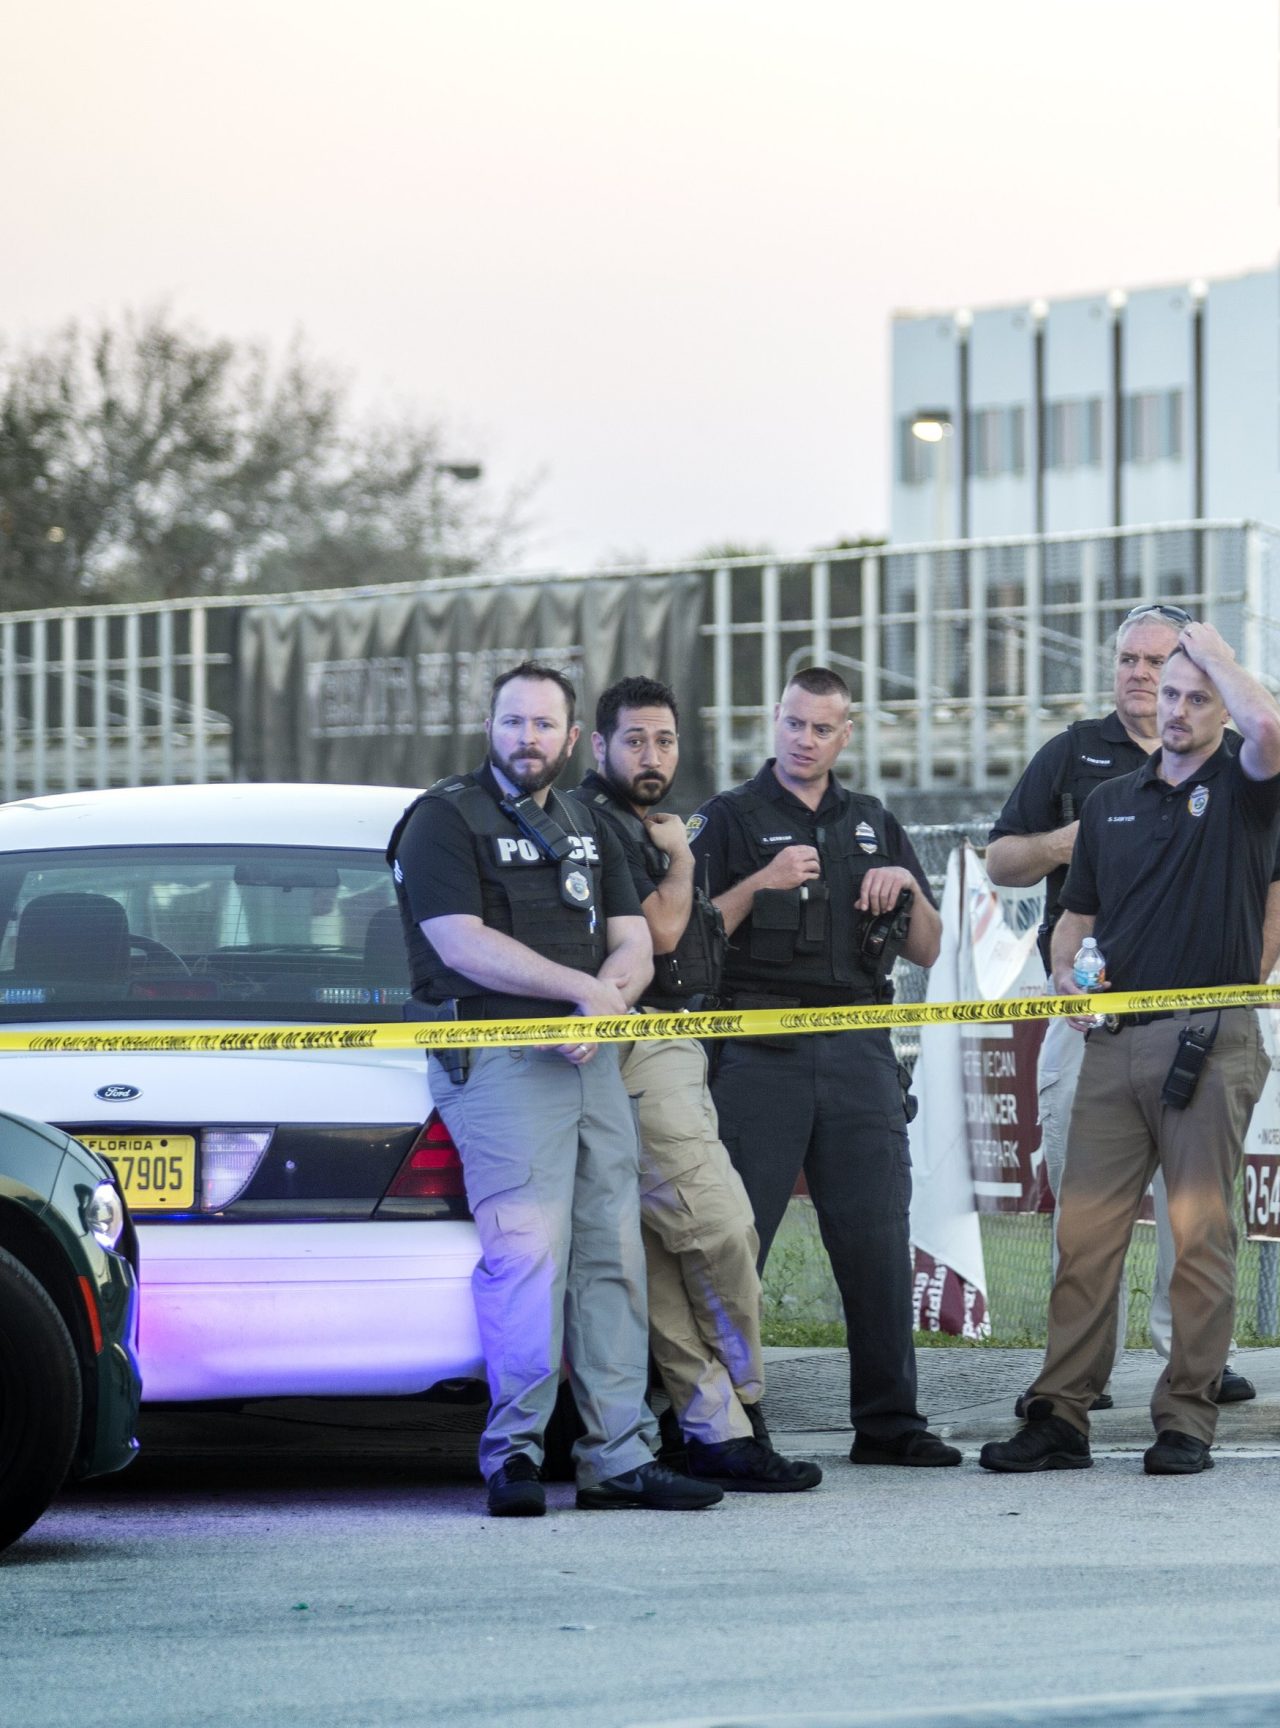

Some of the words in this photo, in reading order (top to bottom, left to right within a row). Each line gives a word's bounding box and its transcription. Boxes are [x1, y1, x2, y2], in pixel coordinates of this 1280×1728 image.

[497, 836, 599, 861] POCE
[104, 1086, 132, 1097] Ford
[89, 1140, 153, 1150] FLORIDA
